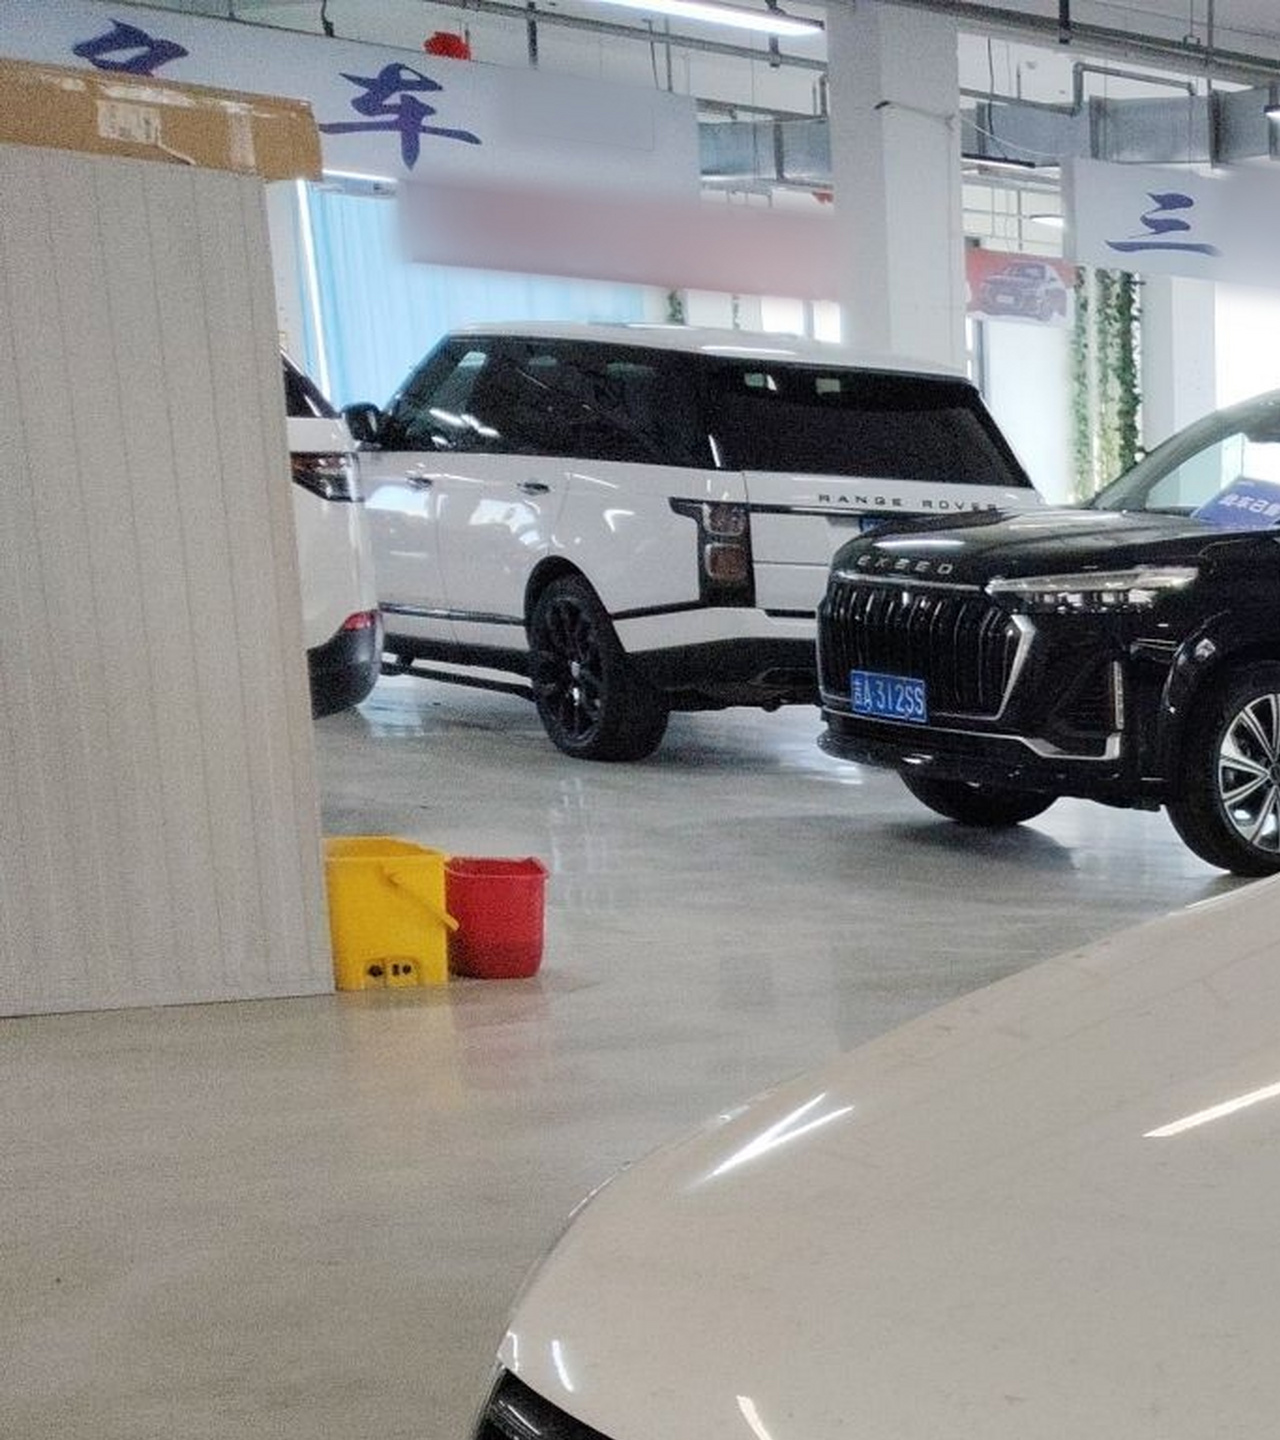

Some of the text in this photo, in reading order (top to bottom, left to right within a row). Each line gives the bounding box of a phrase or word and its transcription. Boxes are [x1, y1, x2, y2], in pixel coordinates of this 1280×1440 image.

[818, 494, 998, 513] RANGE ROVER
[857, 554, 954, 576] EXEED
